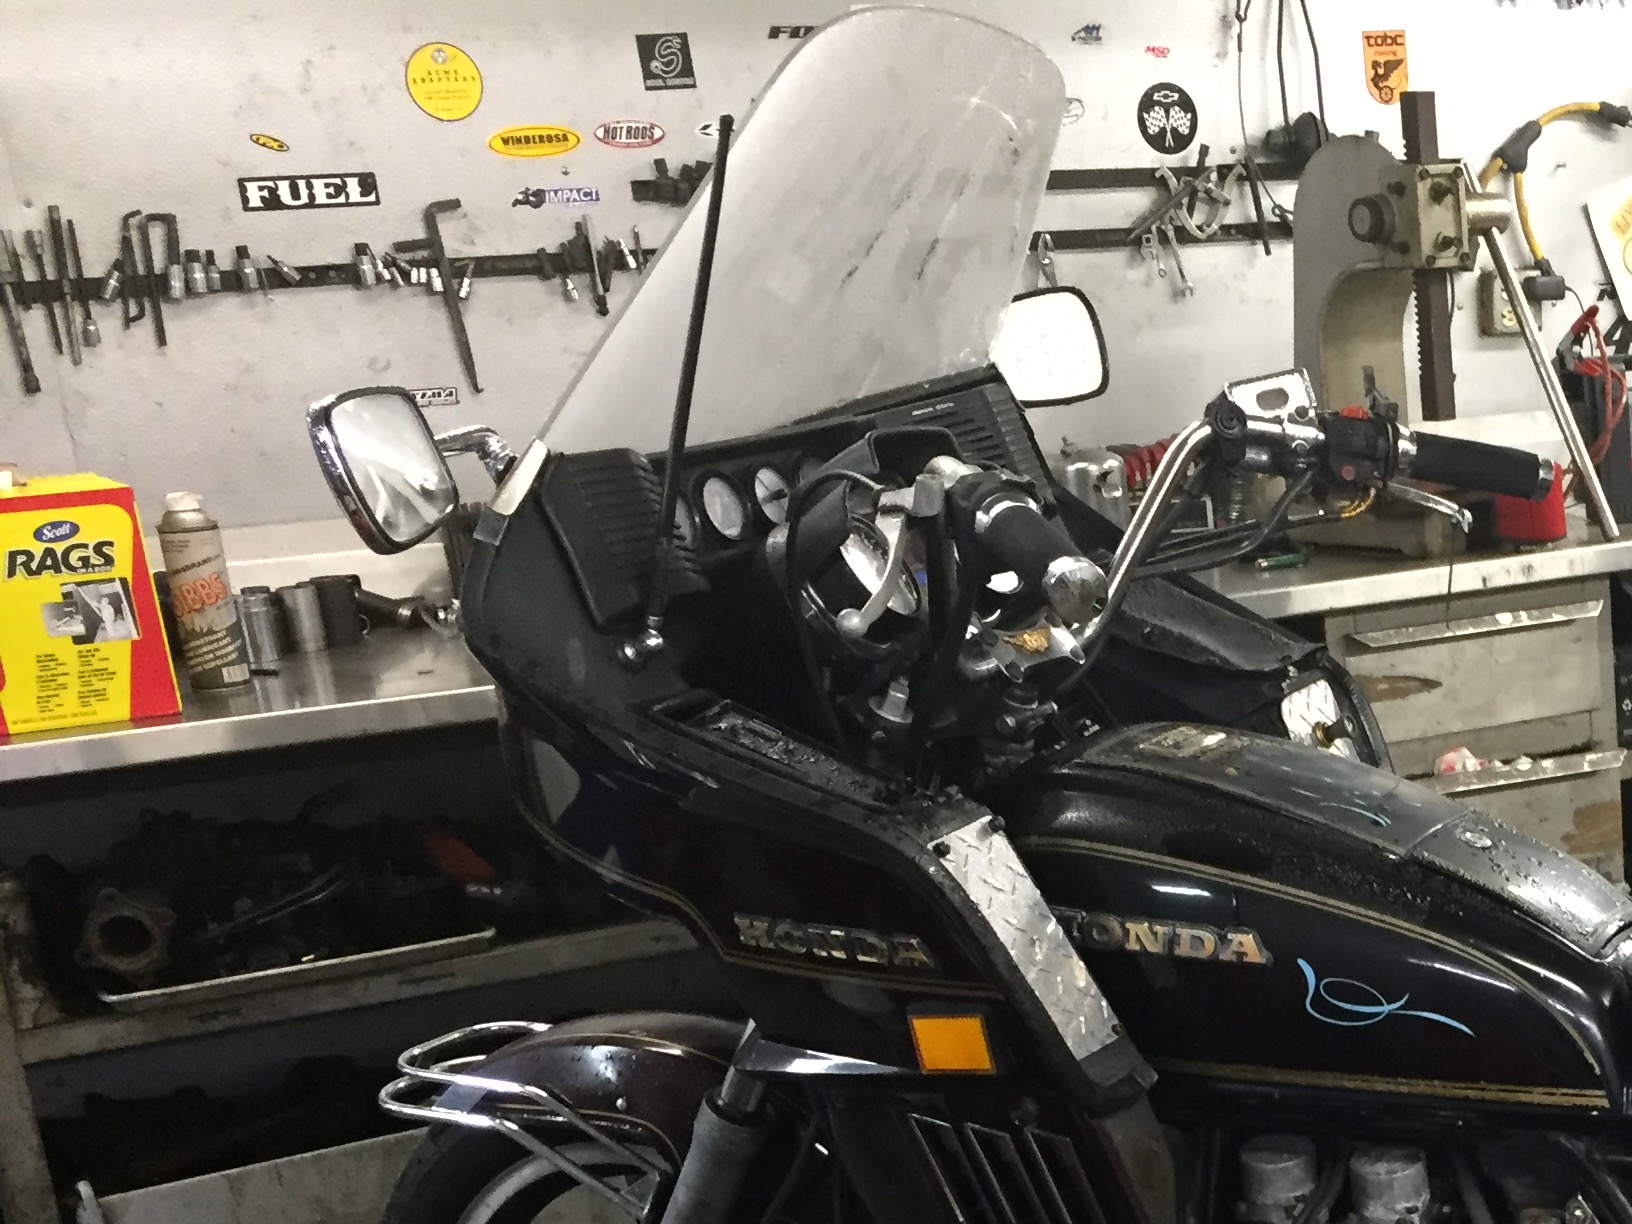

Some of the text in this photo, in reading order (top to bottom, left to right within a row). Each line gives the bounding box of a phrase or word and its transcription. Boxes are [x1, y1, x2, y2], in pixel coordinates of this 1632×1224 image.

[500, 133, 570, 147] WINDEROSA
[603, 124, 656, 141] HOT RODS
[242, 177, 376, 208] FUEL
[545, 188, 599, 203] IMPACT
[42, 522, 71, 541] Scott
[6, 540, 115, 580] RAGS
[733, 912, 935, 969] HONDA
